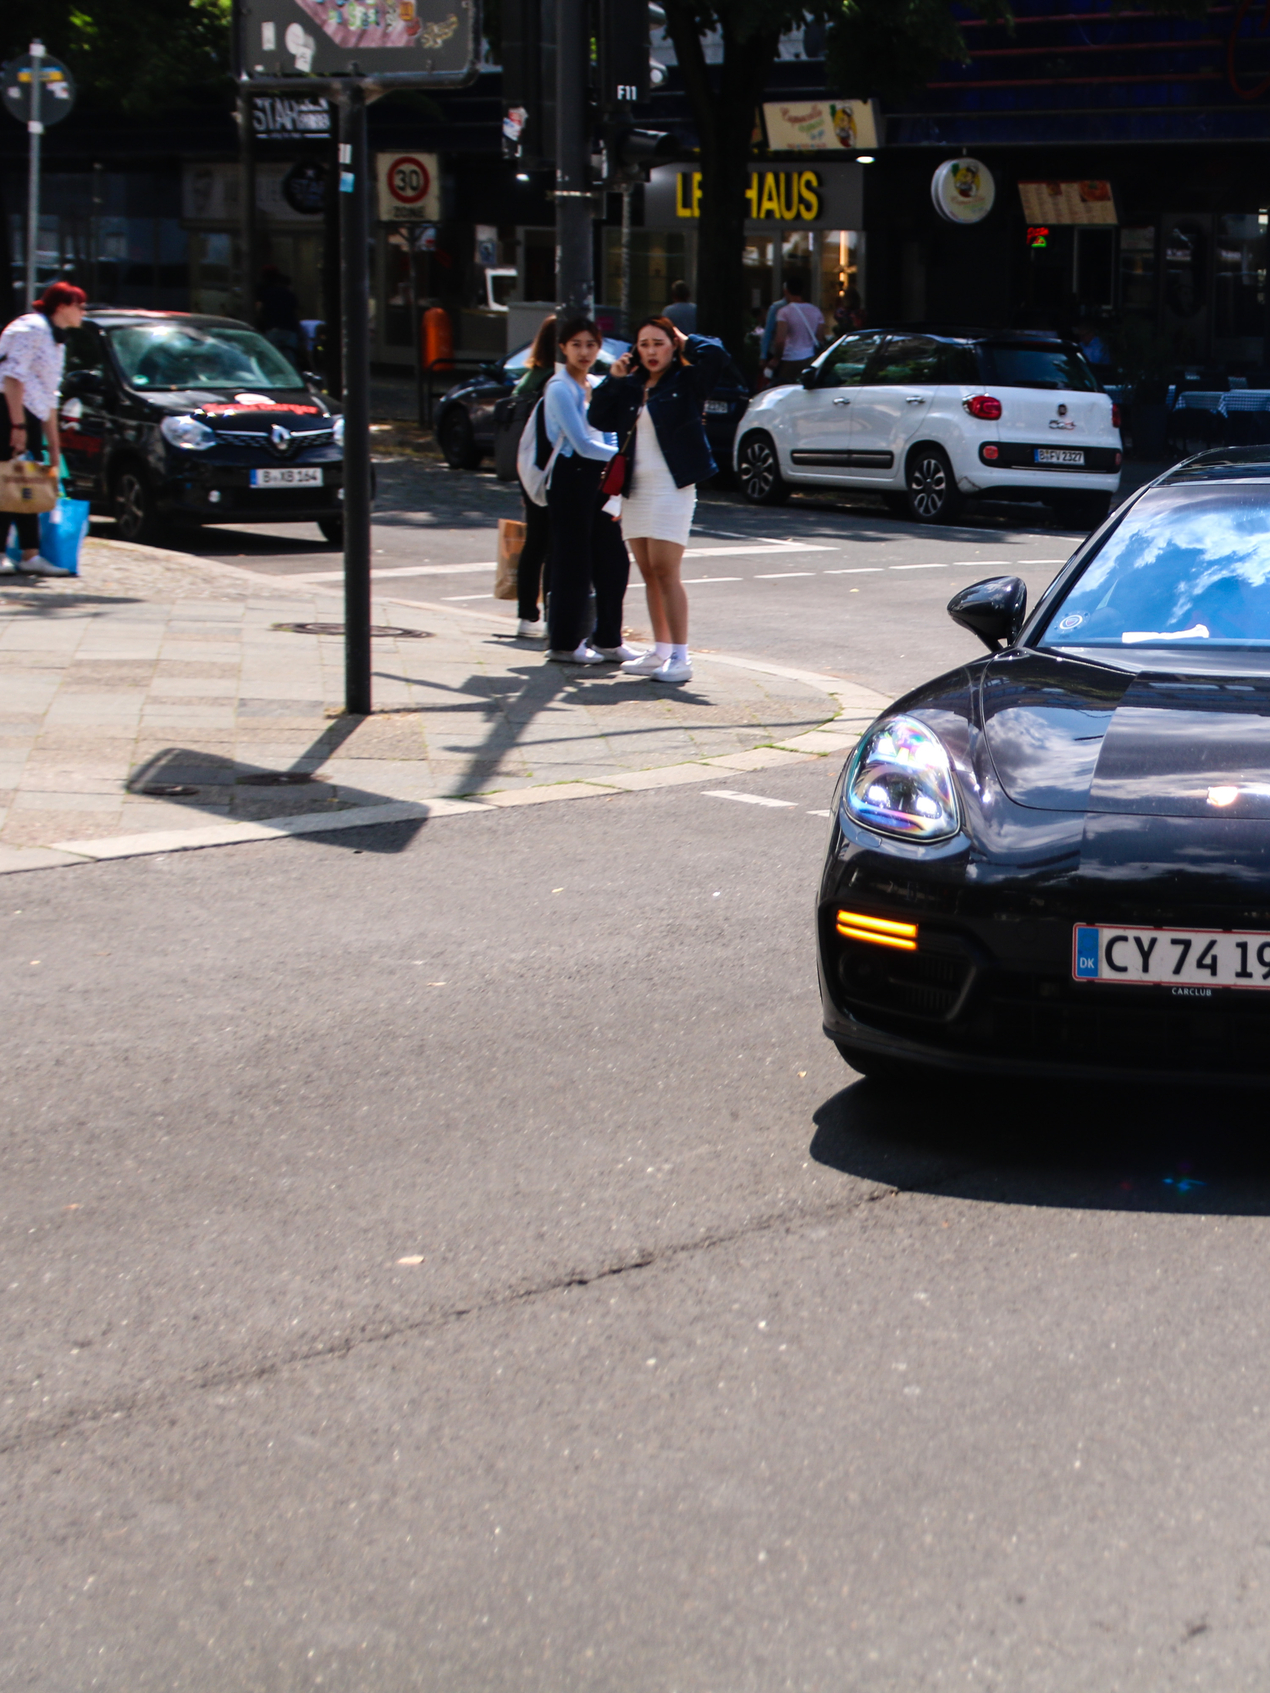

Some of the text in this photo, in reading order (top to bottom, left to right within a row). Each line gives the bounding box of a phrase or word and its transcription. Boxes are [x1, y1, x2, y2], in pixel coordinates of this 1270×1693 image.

[617, 85, 637, 101] F11
[396, 169, 420, 191] 30
[676, 170, 819, 221] LEHAUS
[394, 206, 426, 218] ZONE
[1062, 452, 1082, 462] 2327
[1079, 957, 1095, 969] DK
[1104, 935, 1158, 974] CY
[1170, 938, 1218, 977] 74
[1171, 987, 1212, 997] CARCLUB
